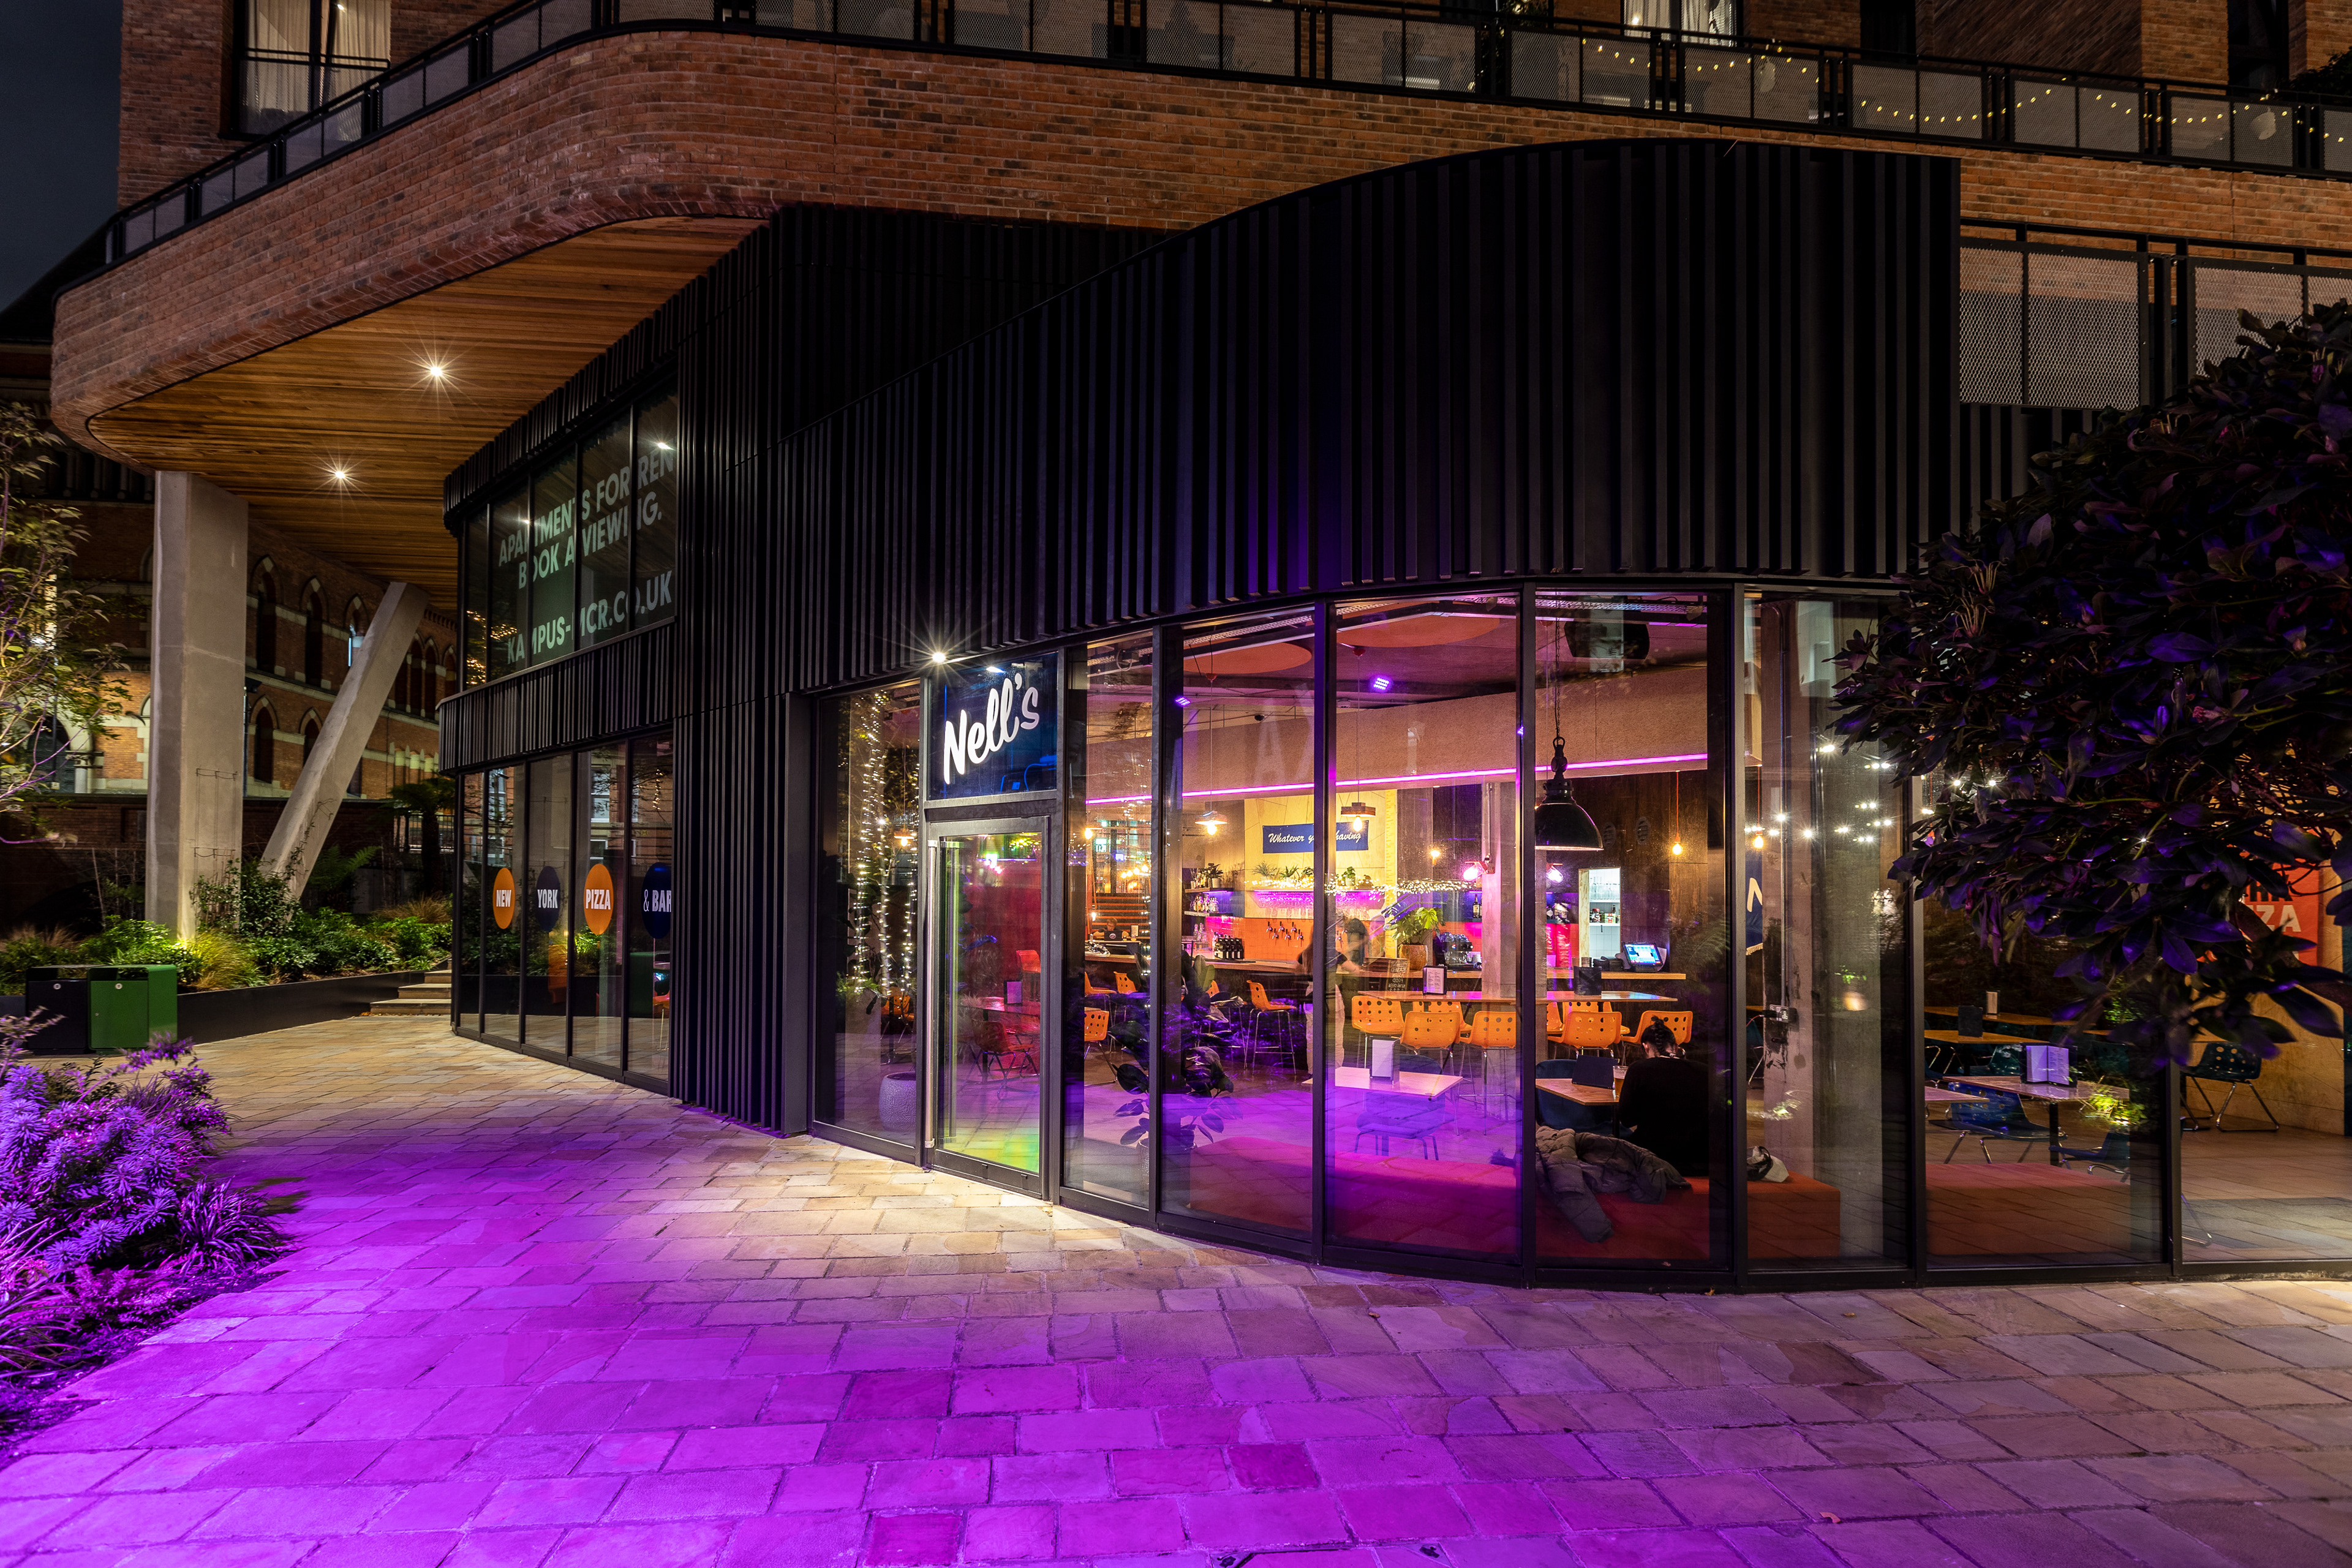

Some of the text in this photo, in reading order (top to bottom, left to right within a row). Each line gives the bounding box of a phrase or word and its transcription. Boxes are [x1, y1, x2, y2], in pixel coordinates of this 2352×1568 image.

[499, 442, 674, 567] APATMENS FOR REN
[564, 535, 575, 567] A
[944, 673, 1039, 785] Nell's
[1268, 833, 1305, 843] Whatever
[496, 889, 671, 912] NEW YORK PIZZA & BAR
